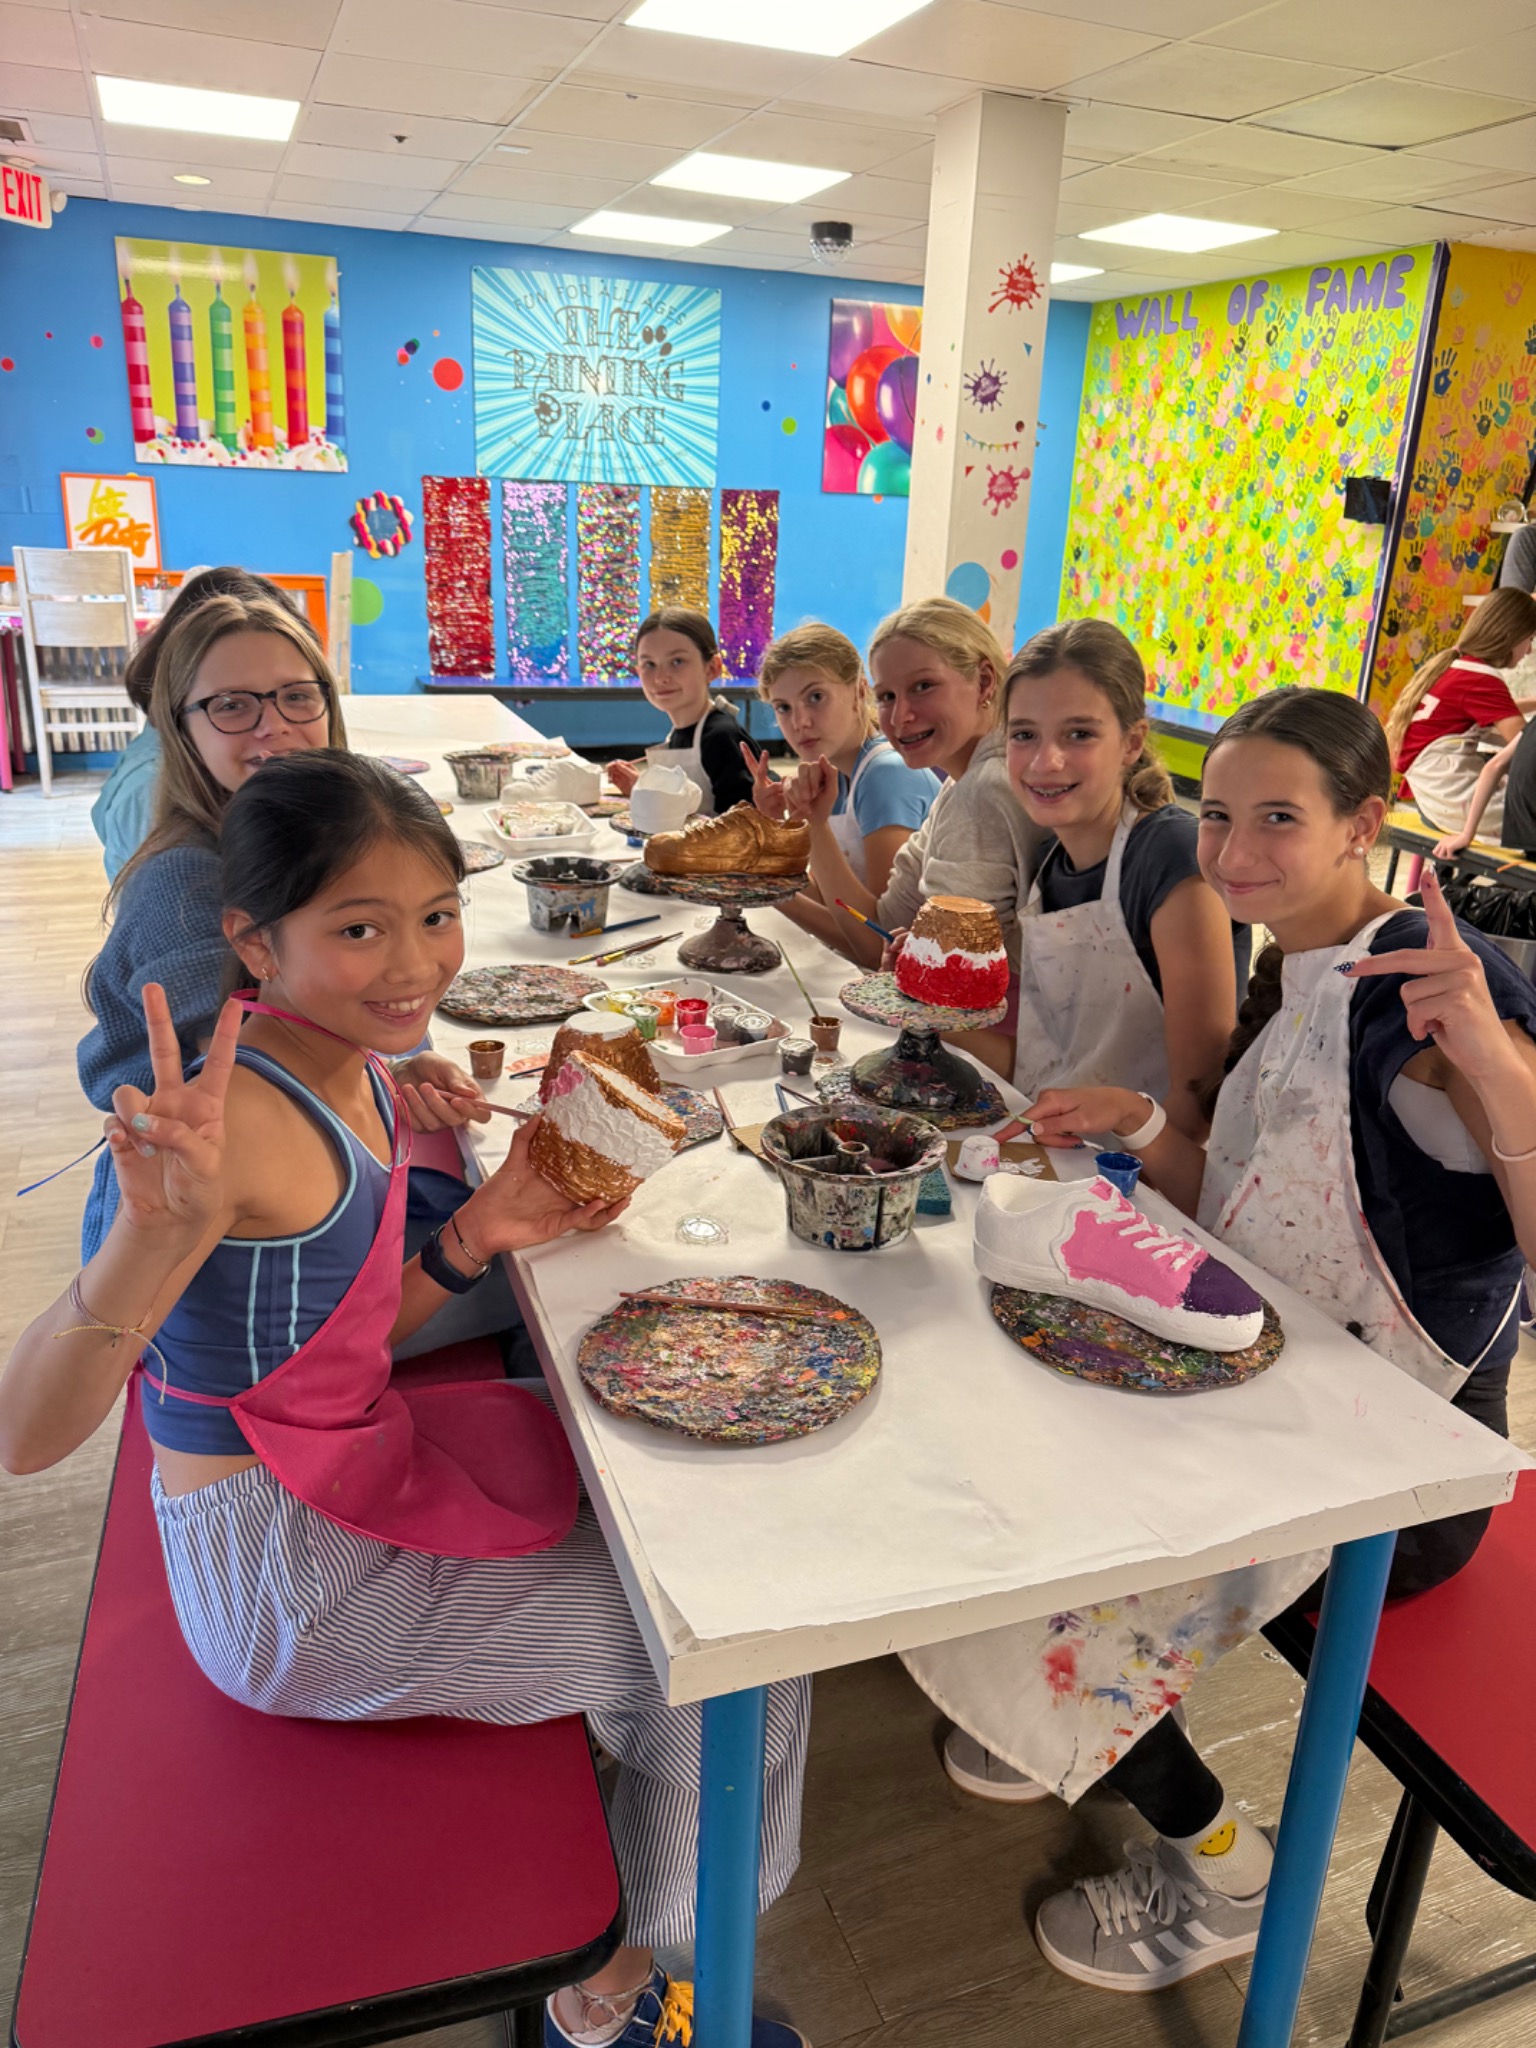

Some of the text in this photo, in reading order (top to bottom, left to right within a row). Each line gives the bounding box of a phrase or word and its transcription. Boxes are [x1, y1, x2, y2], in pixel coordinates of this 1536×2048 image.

[2, 166, 43, 223] EXIT
[513, 284, 688, 326] FUN FOR ALL AGES
[1115, 254, 1415, 341] WALL OF FAME
[554, 305, 640, 352] THE
[504, 348, 686, 403] PAINTING
